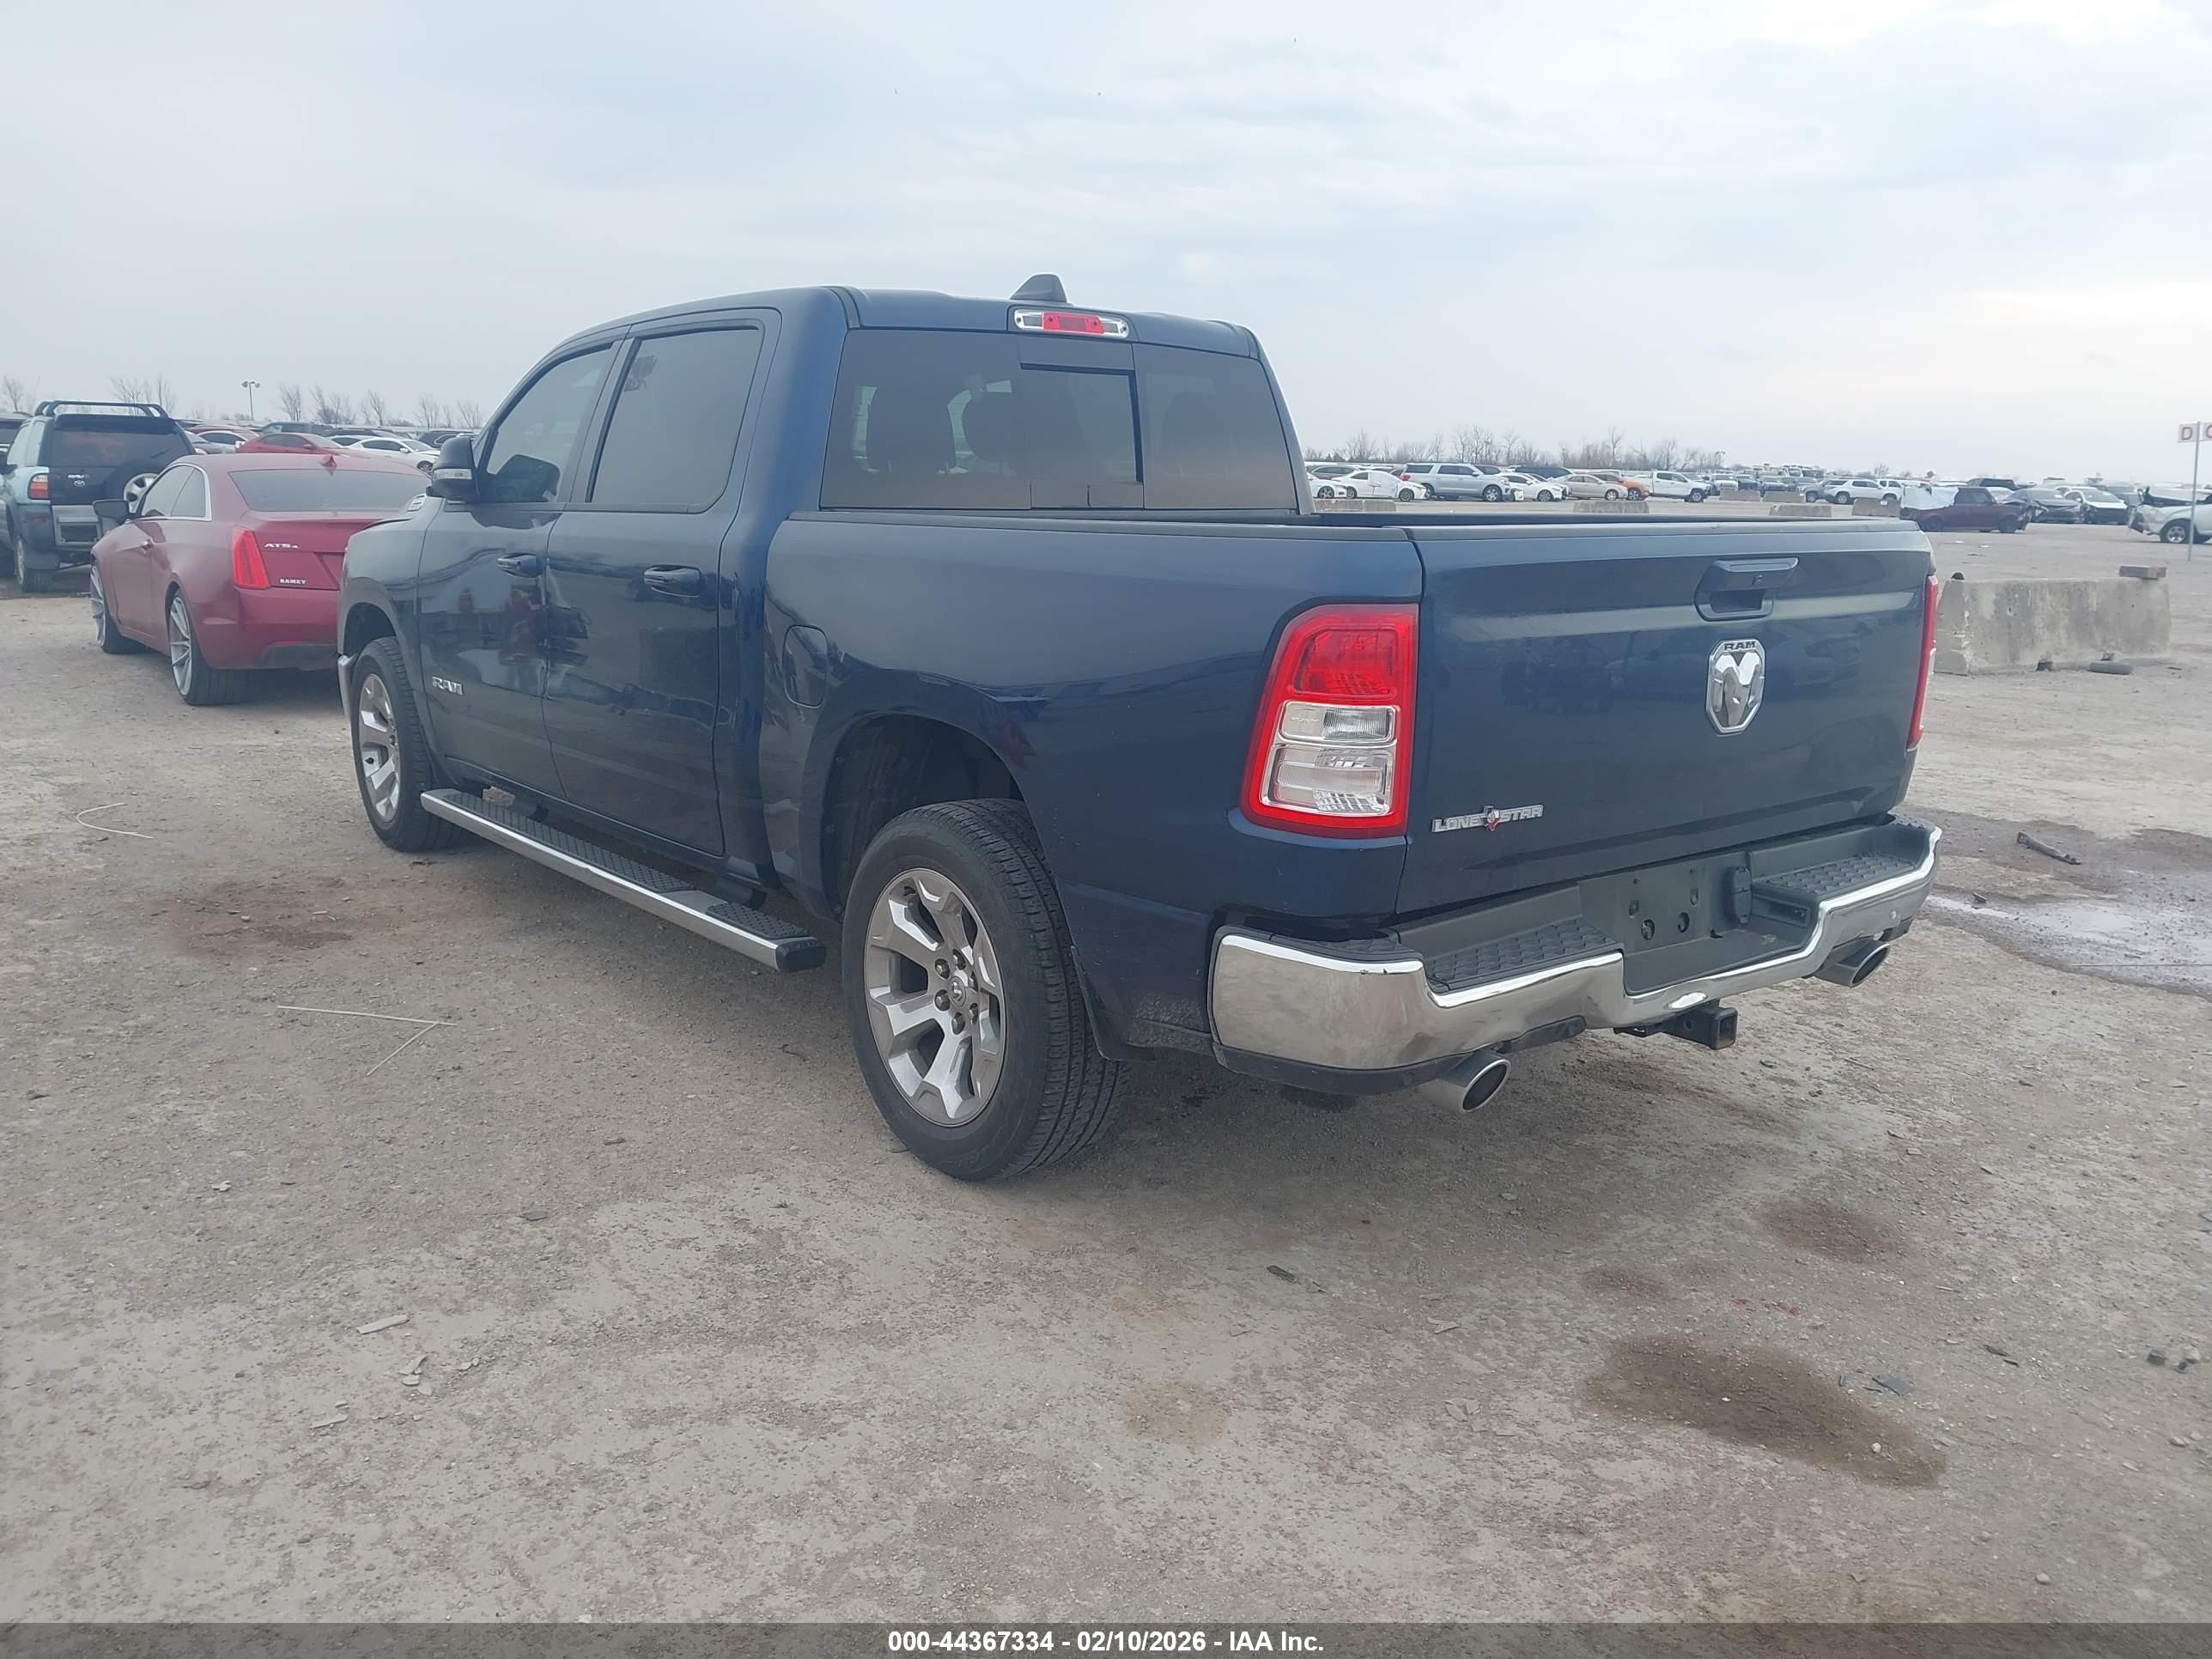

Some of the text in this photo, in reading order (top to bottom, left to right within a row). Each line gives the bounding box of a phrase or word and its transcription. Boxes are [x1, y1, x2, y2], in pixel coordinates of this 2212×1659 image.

[2181, 427, 2194, 440] D
[1723, 641, 1756, 651] RAM
[432, 676, 463, 695] RAM
[1431, 805, 1544, 833] LONE STAR
